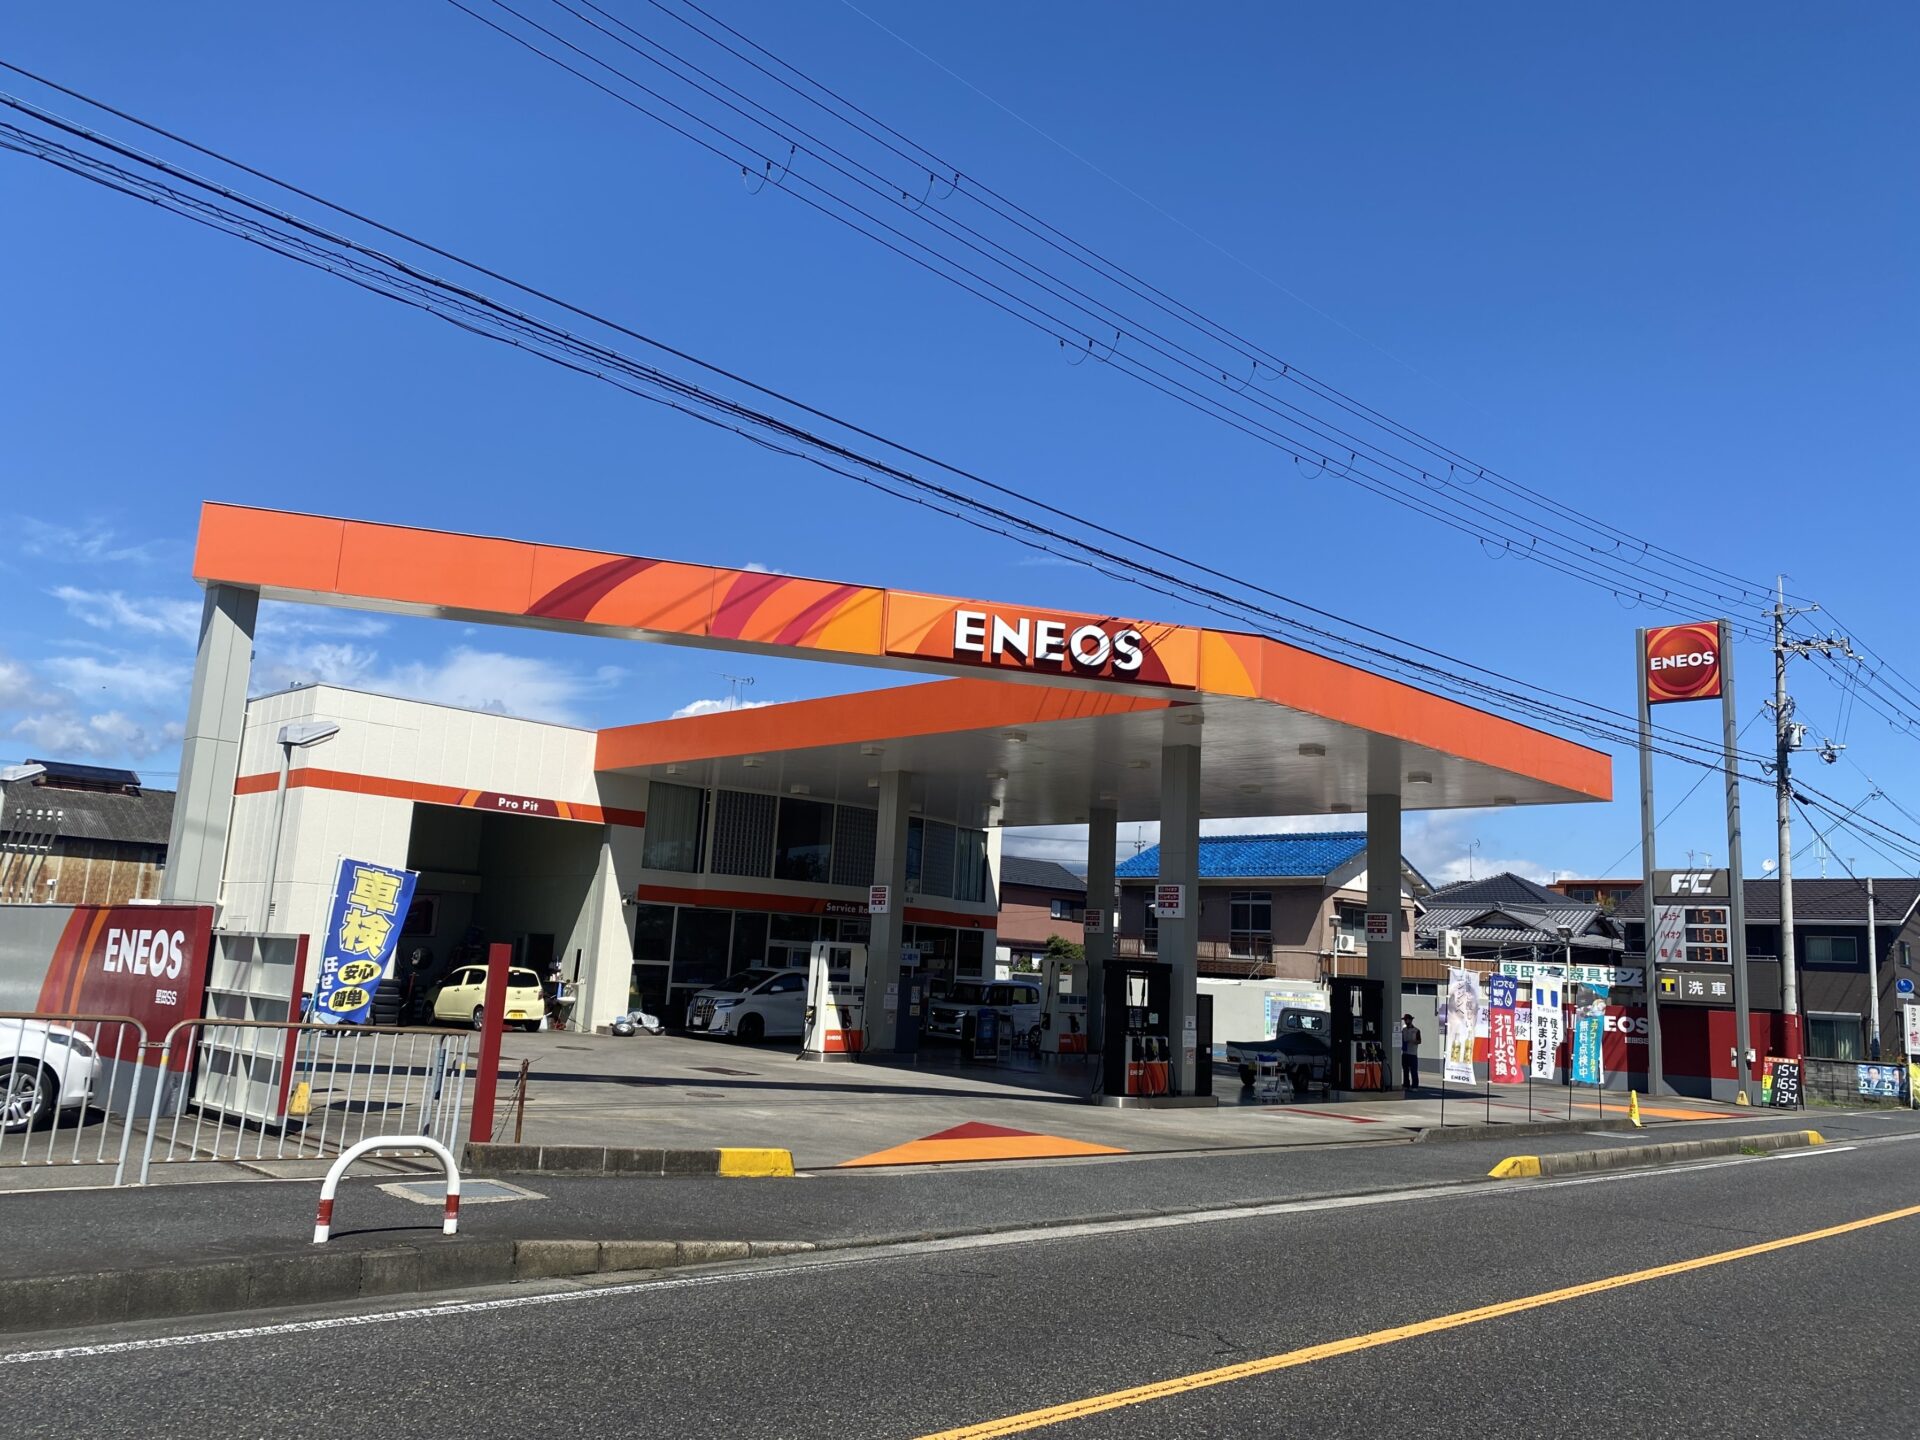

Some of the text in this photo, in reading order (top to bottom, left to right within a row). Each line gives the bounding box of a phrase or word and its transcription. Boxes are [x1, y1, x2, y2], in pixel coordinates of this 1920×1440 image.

[955, 610, 1143, 671] ENEOS
[1650, 651, 1715, 671] ENEOS
[498, 797, 539, 812] Pro Pit
[340, 866, 402, 960] 車検
[826, 902, 856, 913] Service
[1695, 910, 1724, 924] 157
[1660, 928, 1725, 943] ハイオク 168
[103, 928, 185, 979] ENEOS
[1696, 947, 1725, 961] 137
[343, 964, 375, 981] 安心
[318, 956, 339, 1007] 任せて
[1493, 980, 1515, 989] いつでも
[1688, 981, 1727, 996] 洗車
[332, 989, 363, 1008] 簡単
[1494, 1013, 1508, 1076] オイル交換
[1777, 1064, 1799, 1077] 154
[1776, 1077, 1798, 1091] 165
[1776, 1091, 1798, 1105] 134
